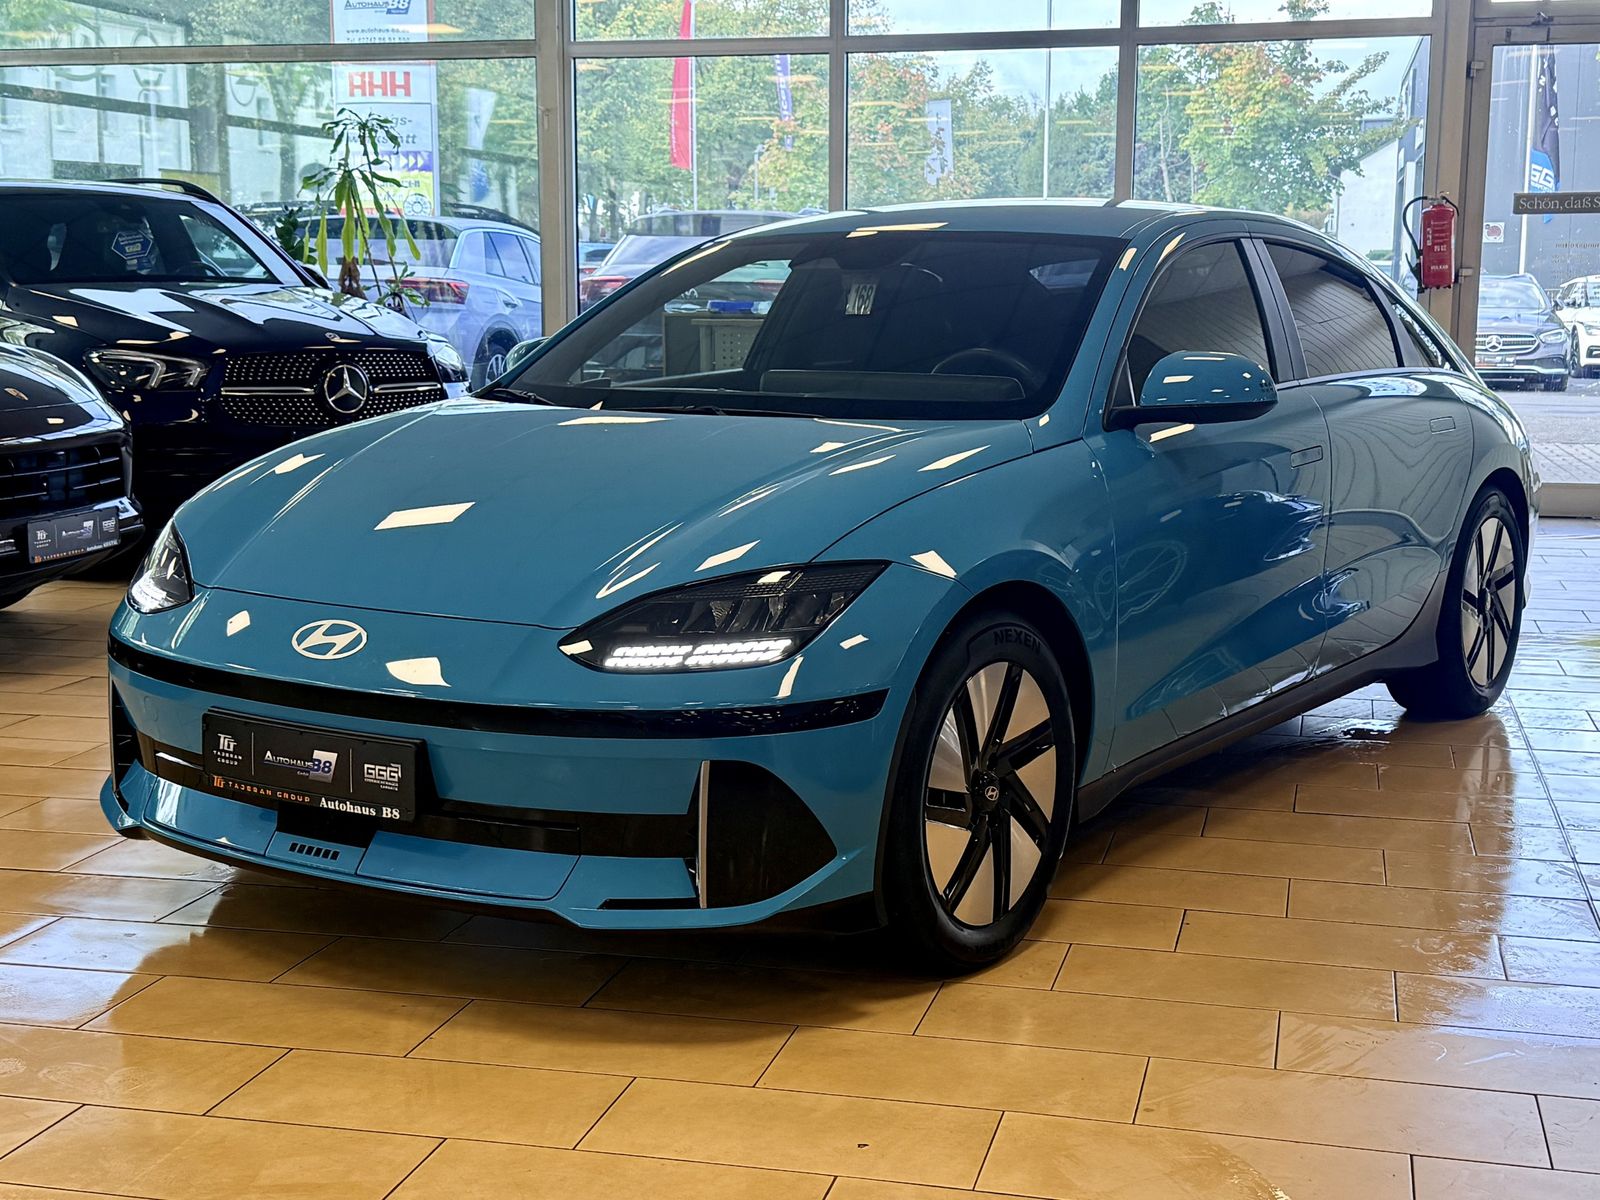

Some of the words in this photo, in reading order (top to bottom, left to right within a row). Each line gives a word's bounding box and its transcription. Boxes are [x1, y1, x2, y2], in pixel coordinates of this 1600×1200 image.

[1565, 196, 1591, 209] daß
[993, 627, 1041, 654] NEXEN
[276, 791, 310, 803] GROUP
[319, 797, 376, 816] Autohaus
[382, 807, 400, 820] B8
